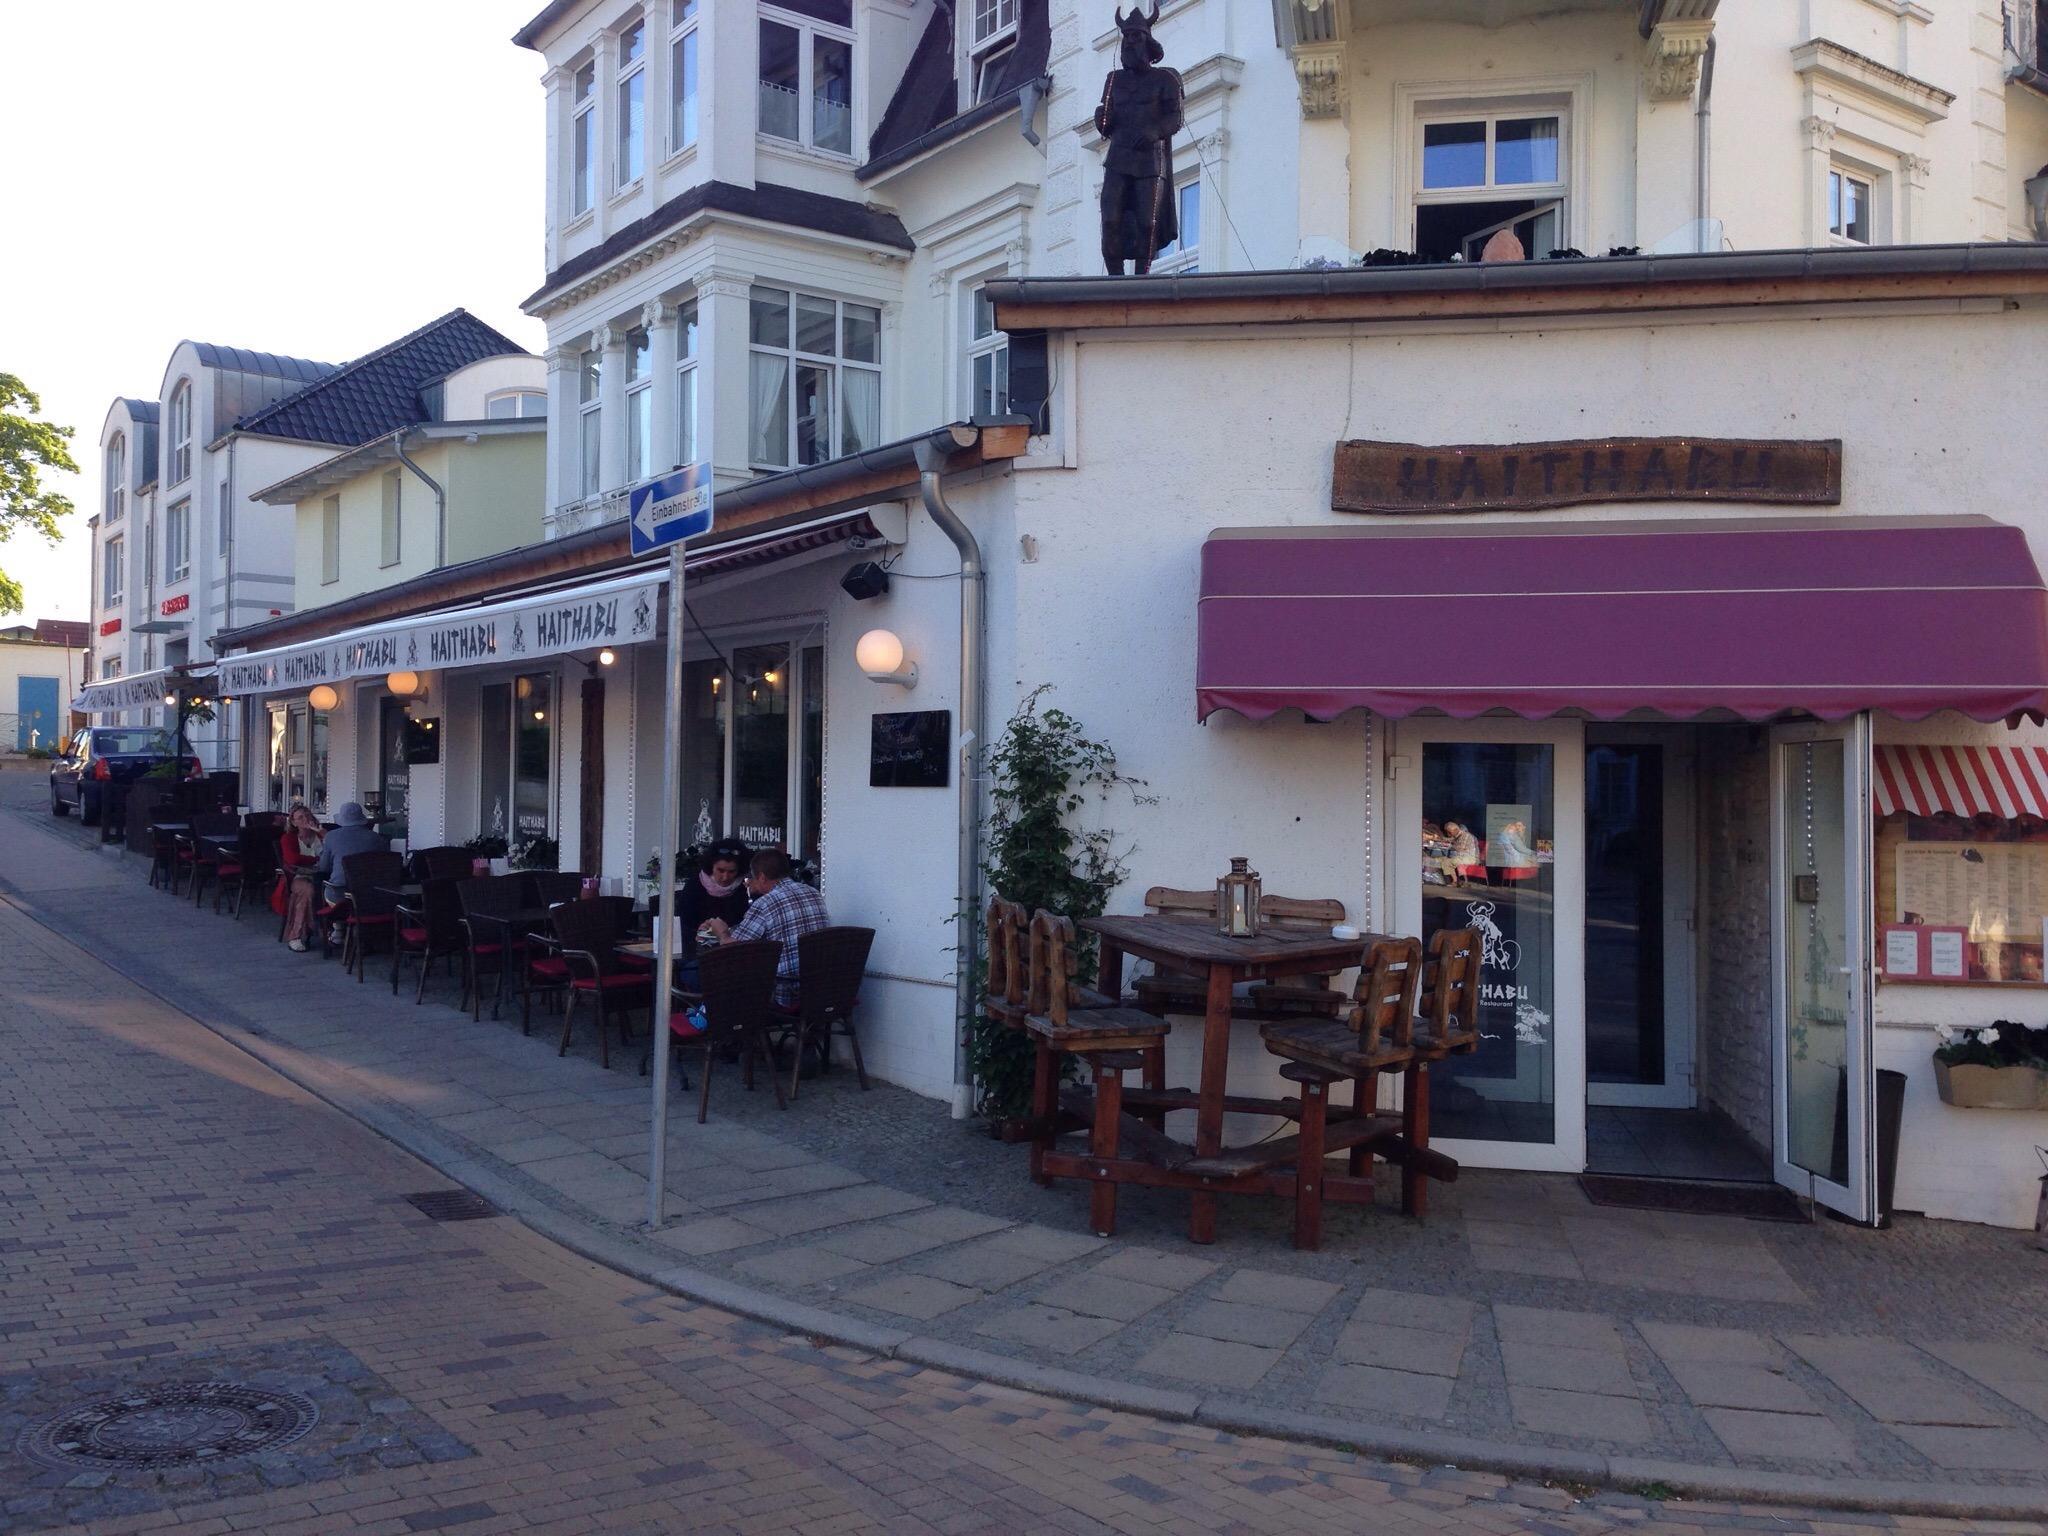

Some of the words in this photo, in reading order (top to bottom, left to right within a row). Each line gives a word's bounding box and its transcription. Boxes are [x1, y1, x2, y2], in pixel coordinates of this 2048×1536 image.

[1399, 446, 1772, 500] HAITHABU
[651, 491, 708, 522] Einbahnstraße
[231, 662, 267, 690] HAITHABU
[285, 650, 327, 683] HAITHABU
[346, 636, 397, 671] HAITHABU
[430, 621, 497, 663] HAITHABU
[537, 598, 619, 648] HAITHABU
[739, 825, 781, 843] HAITHABU
[1477, 983, 1529, 1000] HABU
[1479, 999, 1514, 1008] Restaurant
